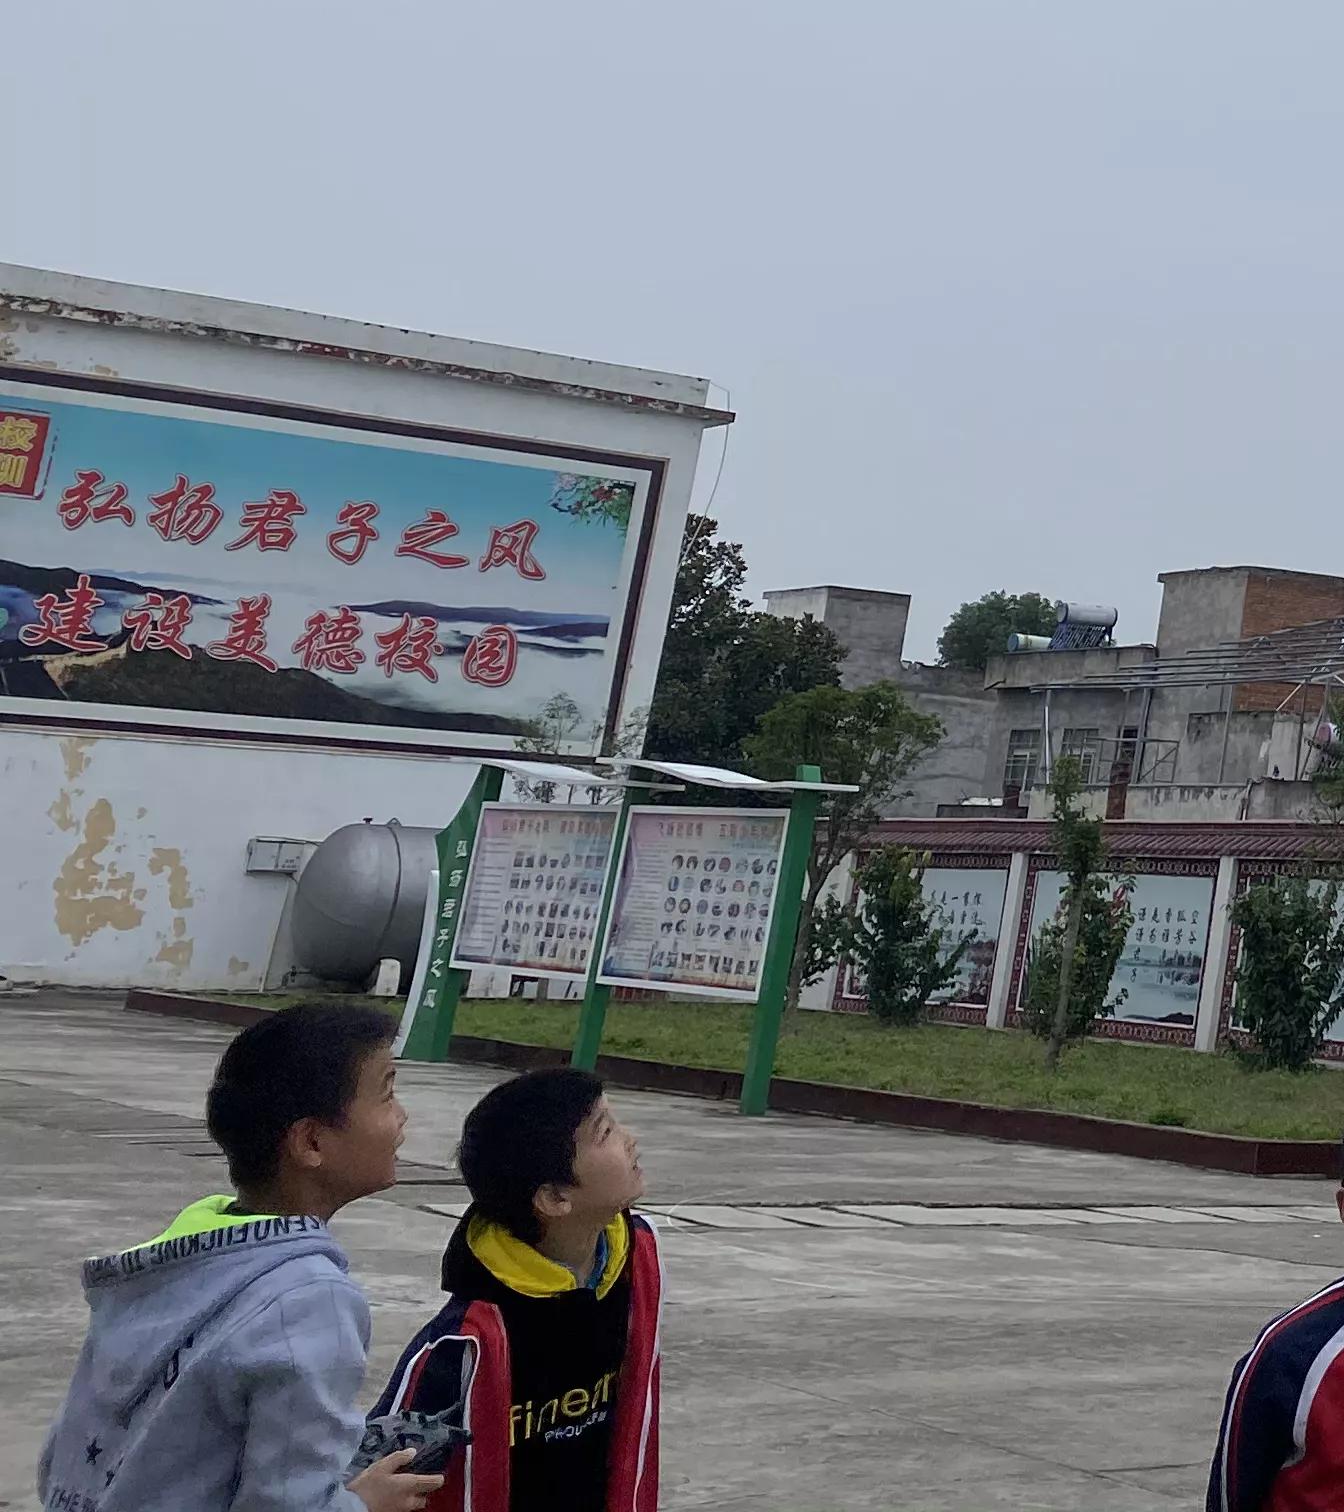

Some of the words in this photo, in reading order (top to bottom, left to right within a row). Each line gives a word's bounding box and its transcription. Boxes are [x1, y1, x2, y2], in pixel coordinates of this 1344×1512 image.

[58, 469, 546, 581] 弘扬君子之风
[19, 574, 519, 687] 建设美德校园
